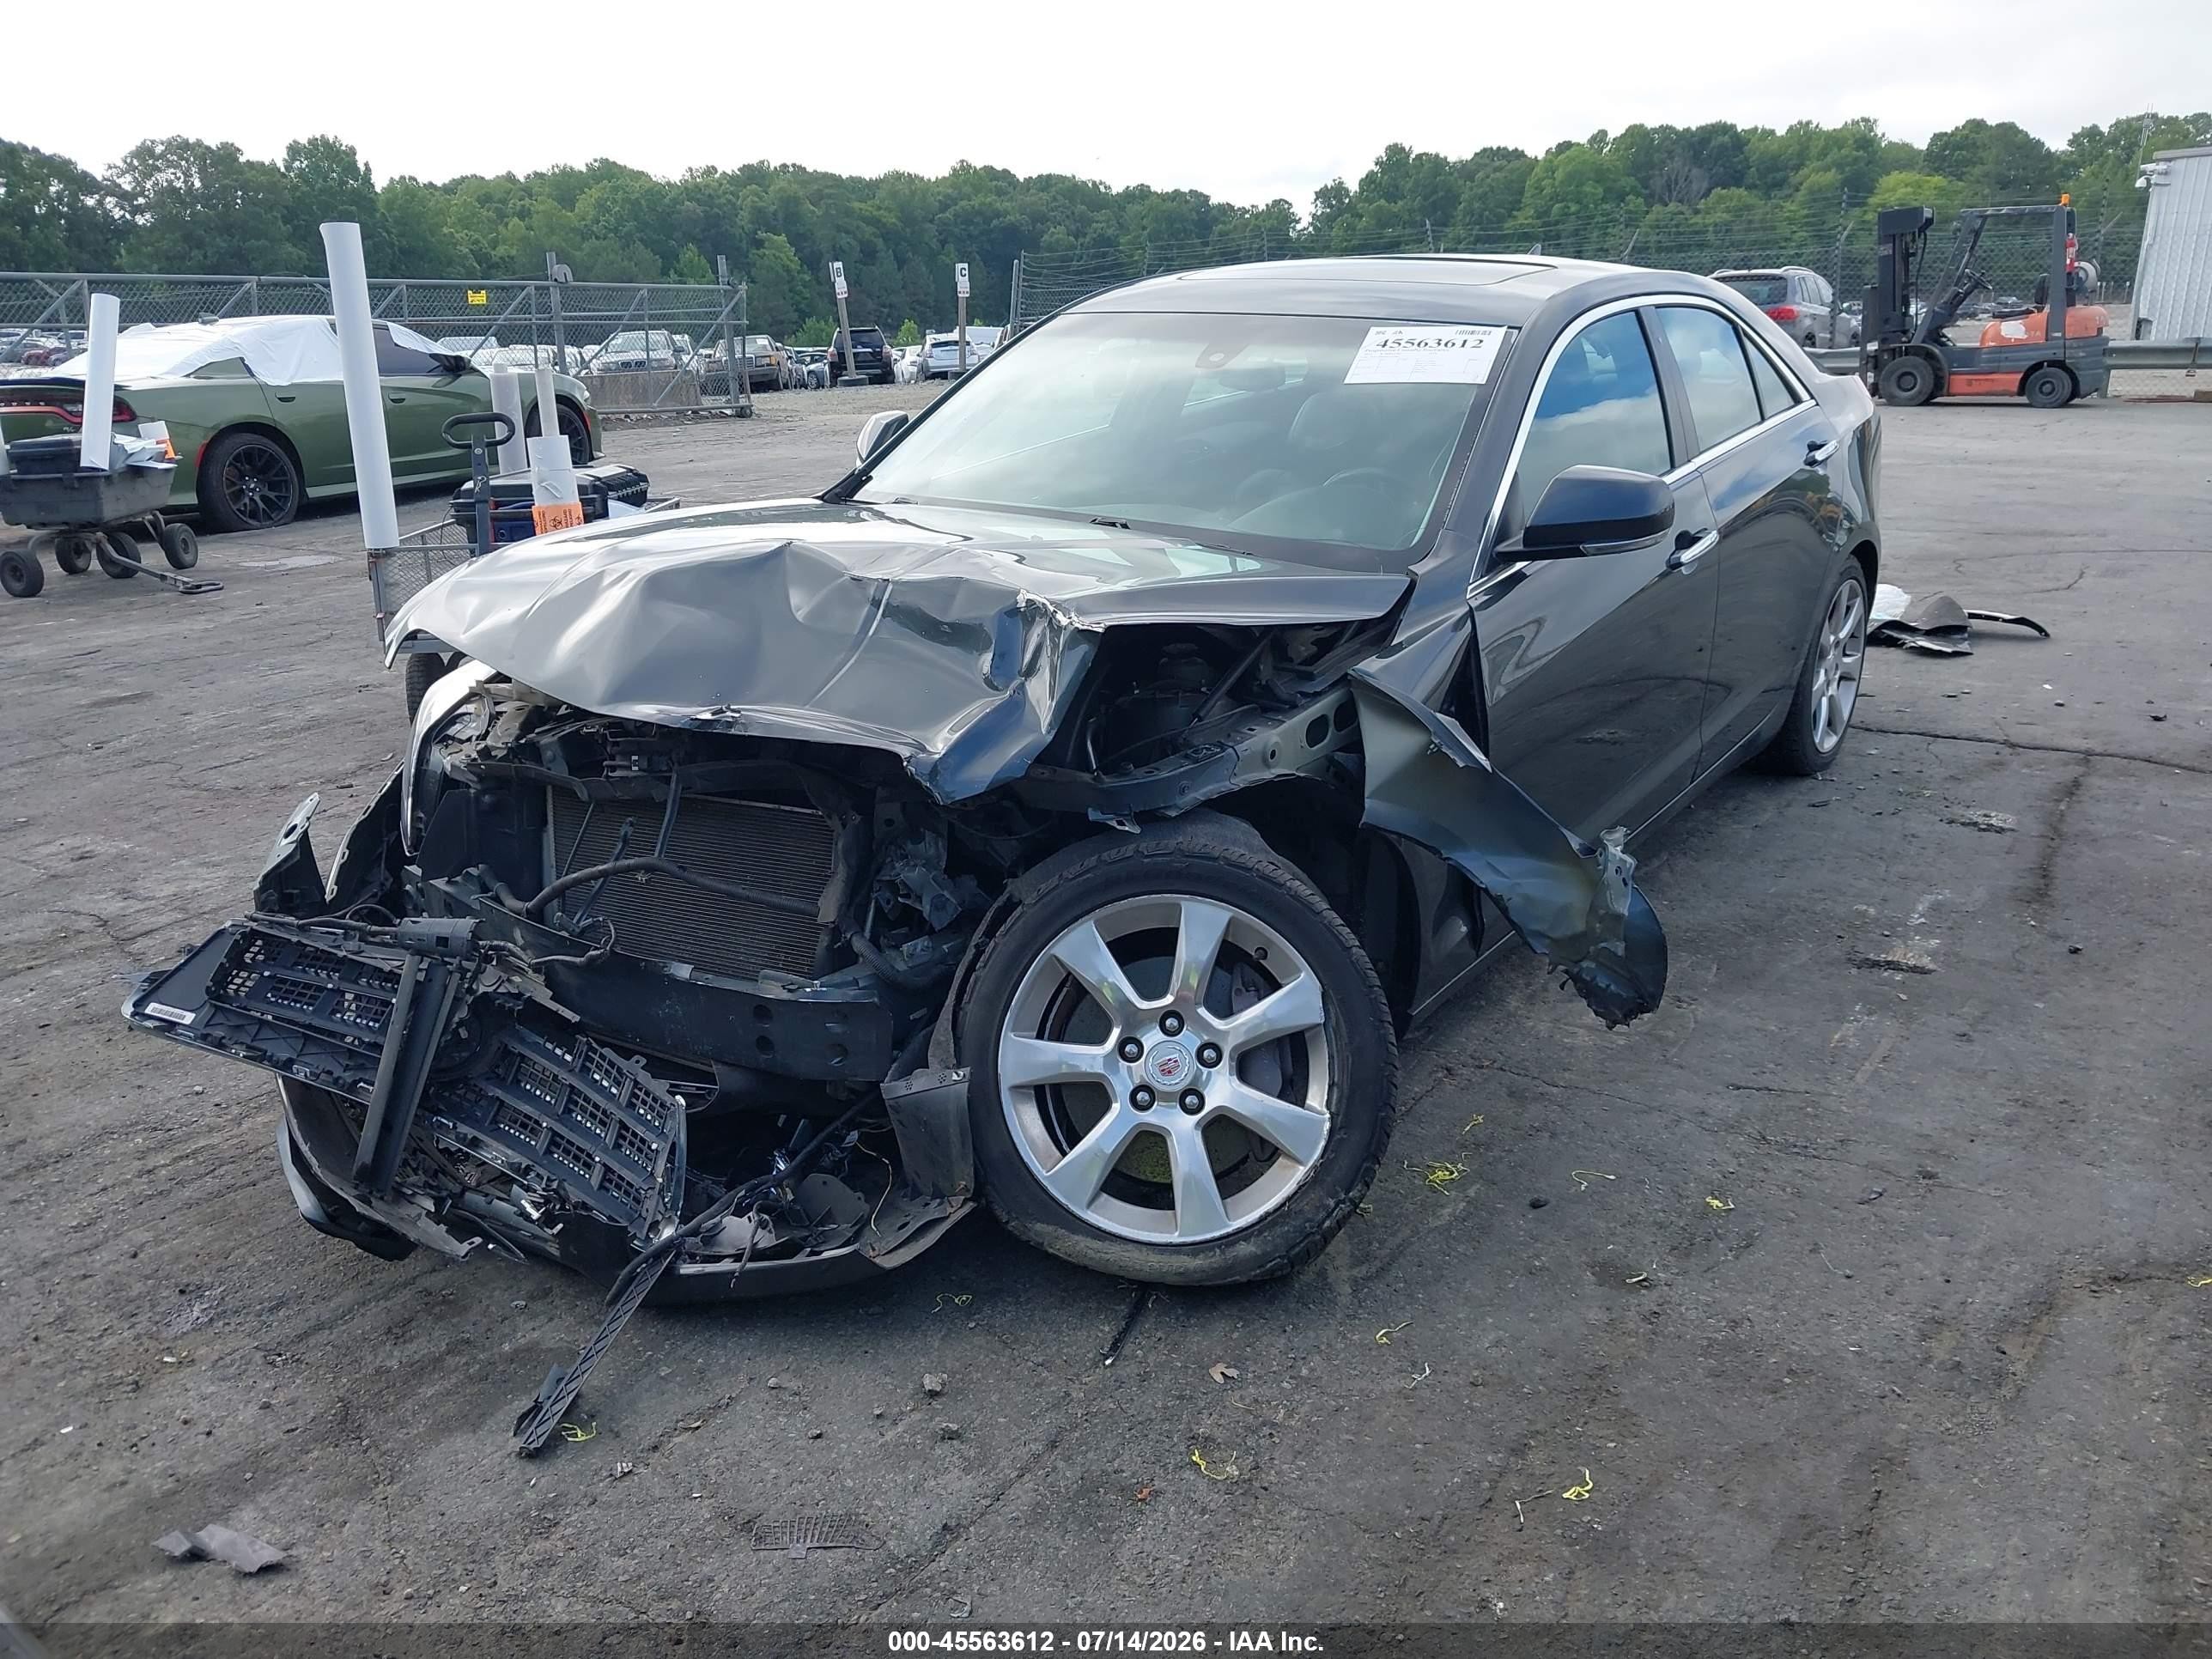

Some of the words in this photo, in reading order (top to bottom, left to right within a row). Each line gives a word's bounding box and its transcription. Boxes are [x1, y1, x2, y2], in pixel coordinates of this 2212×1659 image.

[836, 267, 842, 277] B
[960, 267, 967, 277] C
[1376, 338, 1483, 349] 45563612
